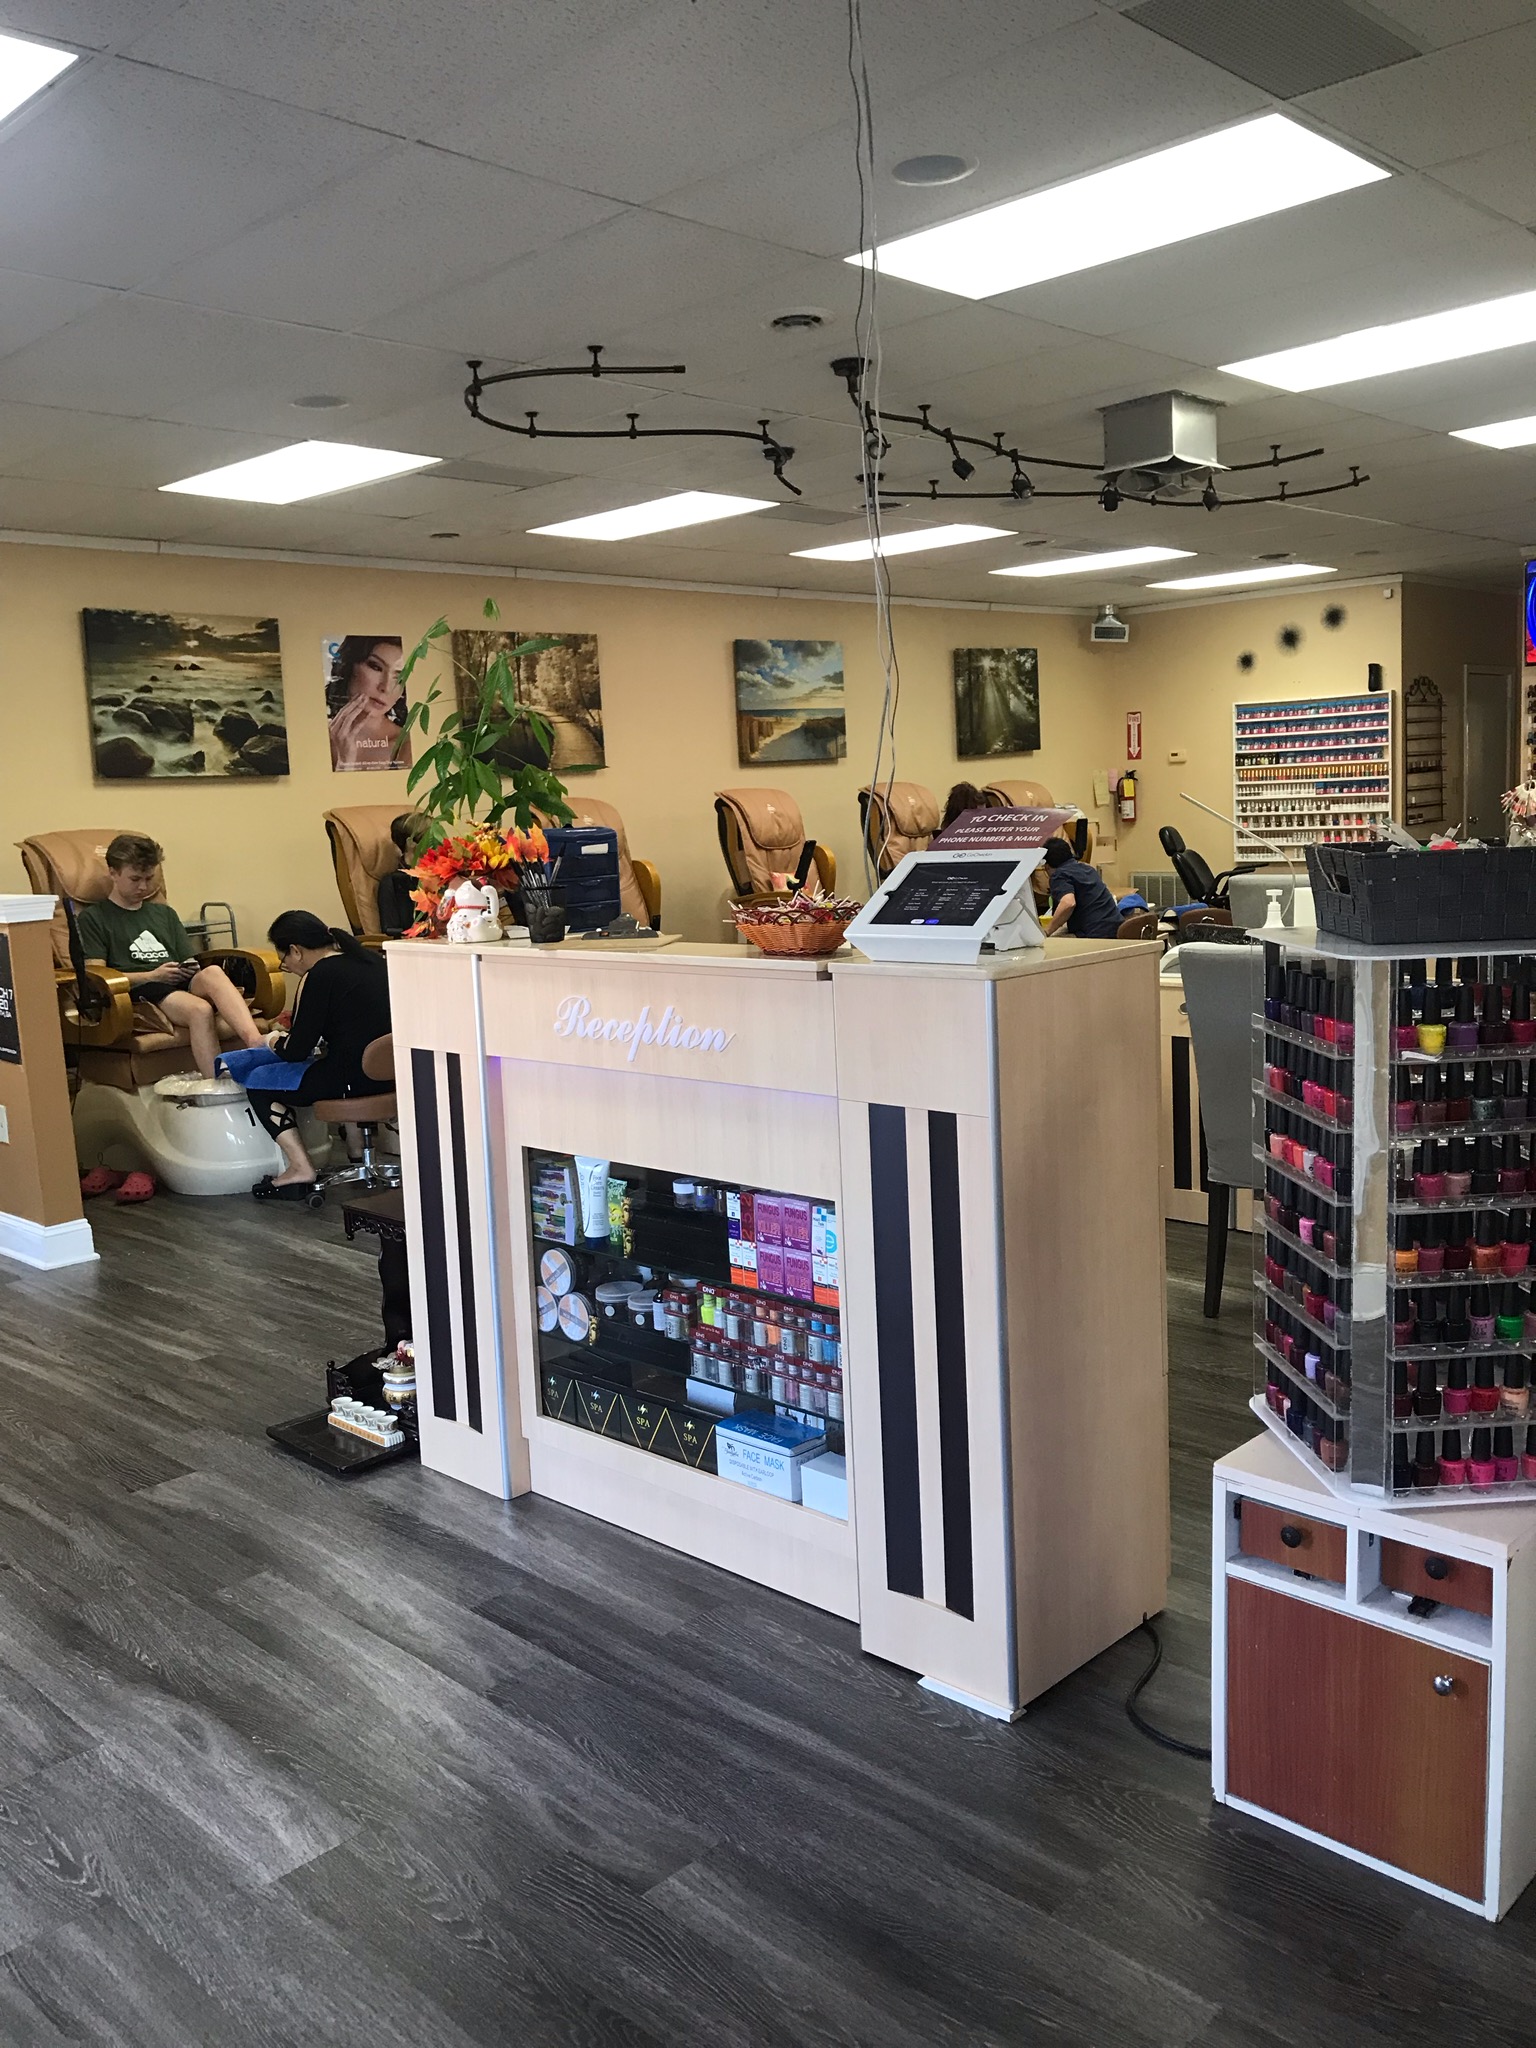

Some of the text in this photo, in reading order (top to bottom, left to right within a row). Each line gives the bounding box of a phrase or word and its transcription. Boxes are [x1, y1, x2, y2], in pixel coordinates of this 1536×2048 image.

[356, 736, 388, 748] natural
[970, 815, 987, 823] TO
[988, 814, 1030, 822] CHECK
[554, 995, 736, 1062] Reception
[245, 1107, 256, 1127] 1
[757, 1203, 780, 1217] FUNGUS
[784, 1207, 808, 1220] FUNGUS
[760, 1251, 781, 1265] FUNGUS
[786, 1257, 810, 1271] FUNGUS
[547, 1388, 559, 1398] SPA
[590, 1402, 602, 1413] SPA
[636, 1416, 650, 1428] SPA
[683, 1433, 697, 1445] SPA
[733, 1424, 783, 1443] FACE MASK
[742, 1449, 760, 1464] FACE
[764, 1455, 785, 1471] MASK
